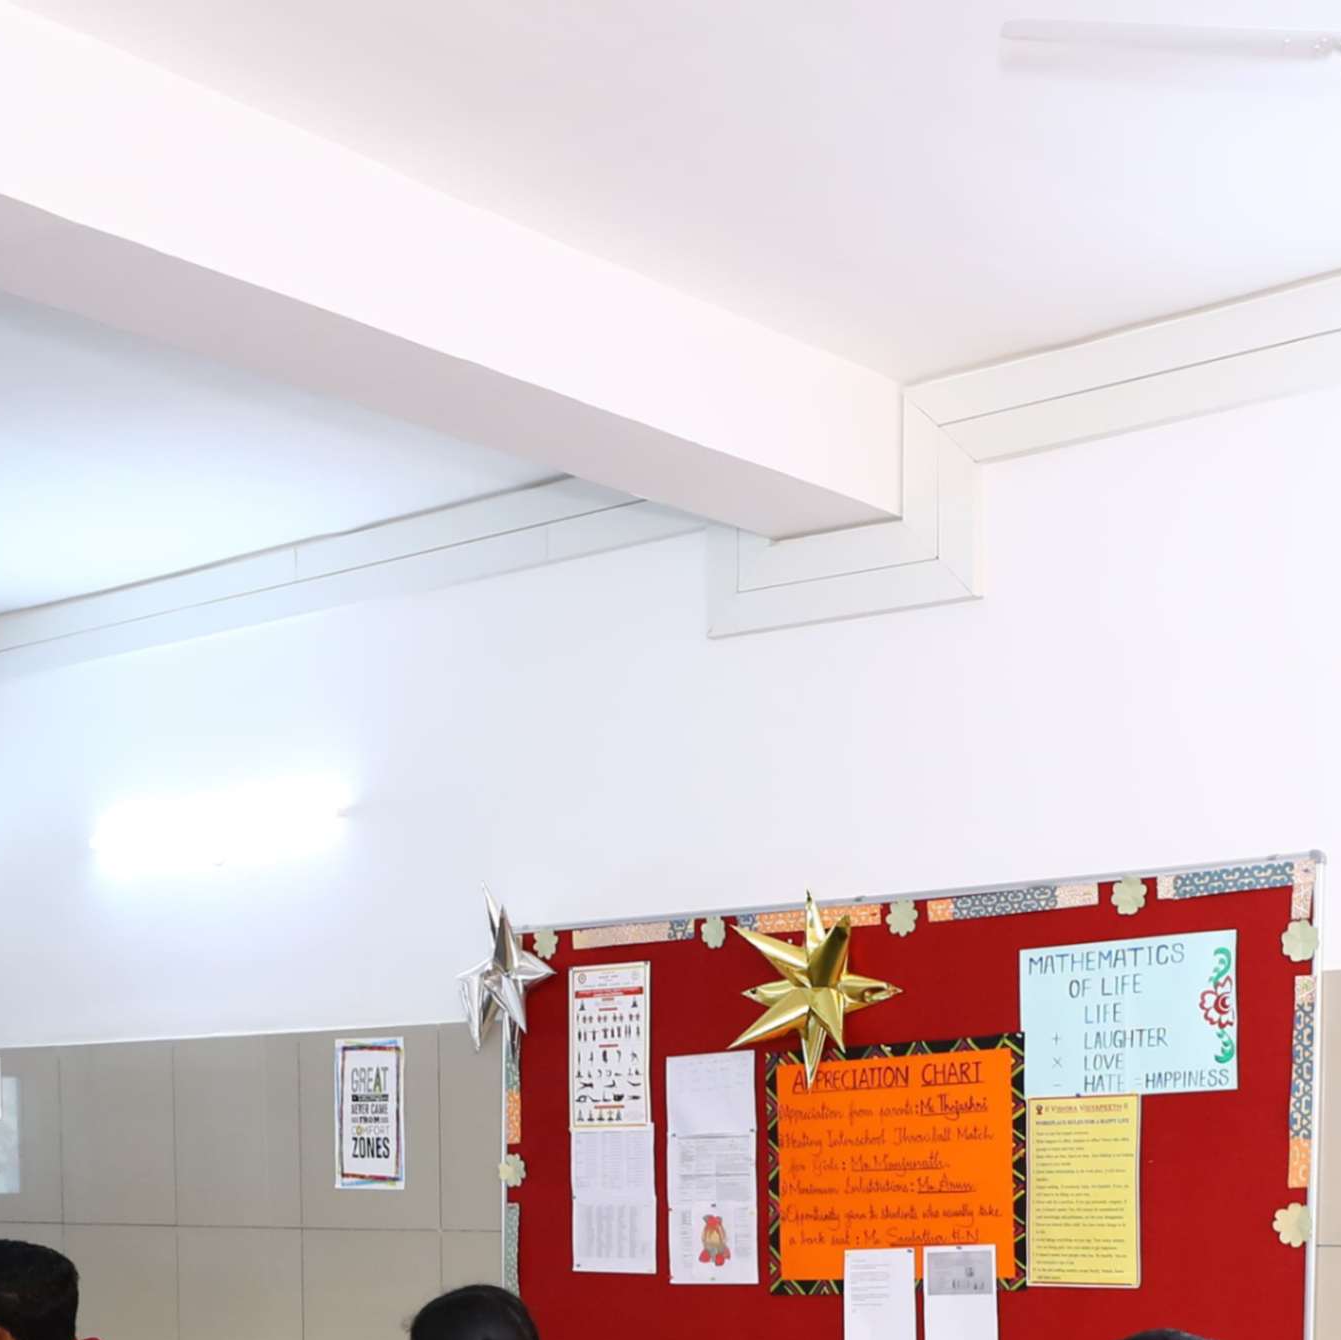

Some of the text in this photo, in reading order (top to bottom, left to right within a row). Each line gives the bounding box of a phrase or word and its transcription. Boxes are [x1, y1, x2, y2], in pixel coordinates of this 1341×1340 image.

[1028, 943, 1186, 976] MATHEMATICS
[1068, 973, 1144, 999] OF LIFE
[1084, 1002, 1124, 1025] LIFE
[1084, 1027, 1169, 1050] LAUGHTER
[1084, 1053, 1124, 1072] LOVE
[351, 1066, 389, 1093] GREAT
[792, 1060, 983, 1093] APRECIATION CHART
[1084, 1074, 1125, 1093] HATE
[1145, 1068, 1230, 1089] HAPPINESS
[352, 1136, 391, 1159] ZONES
